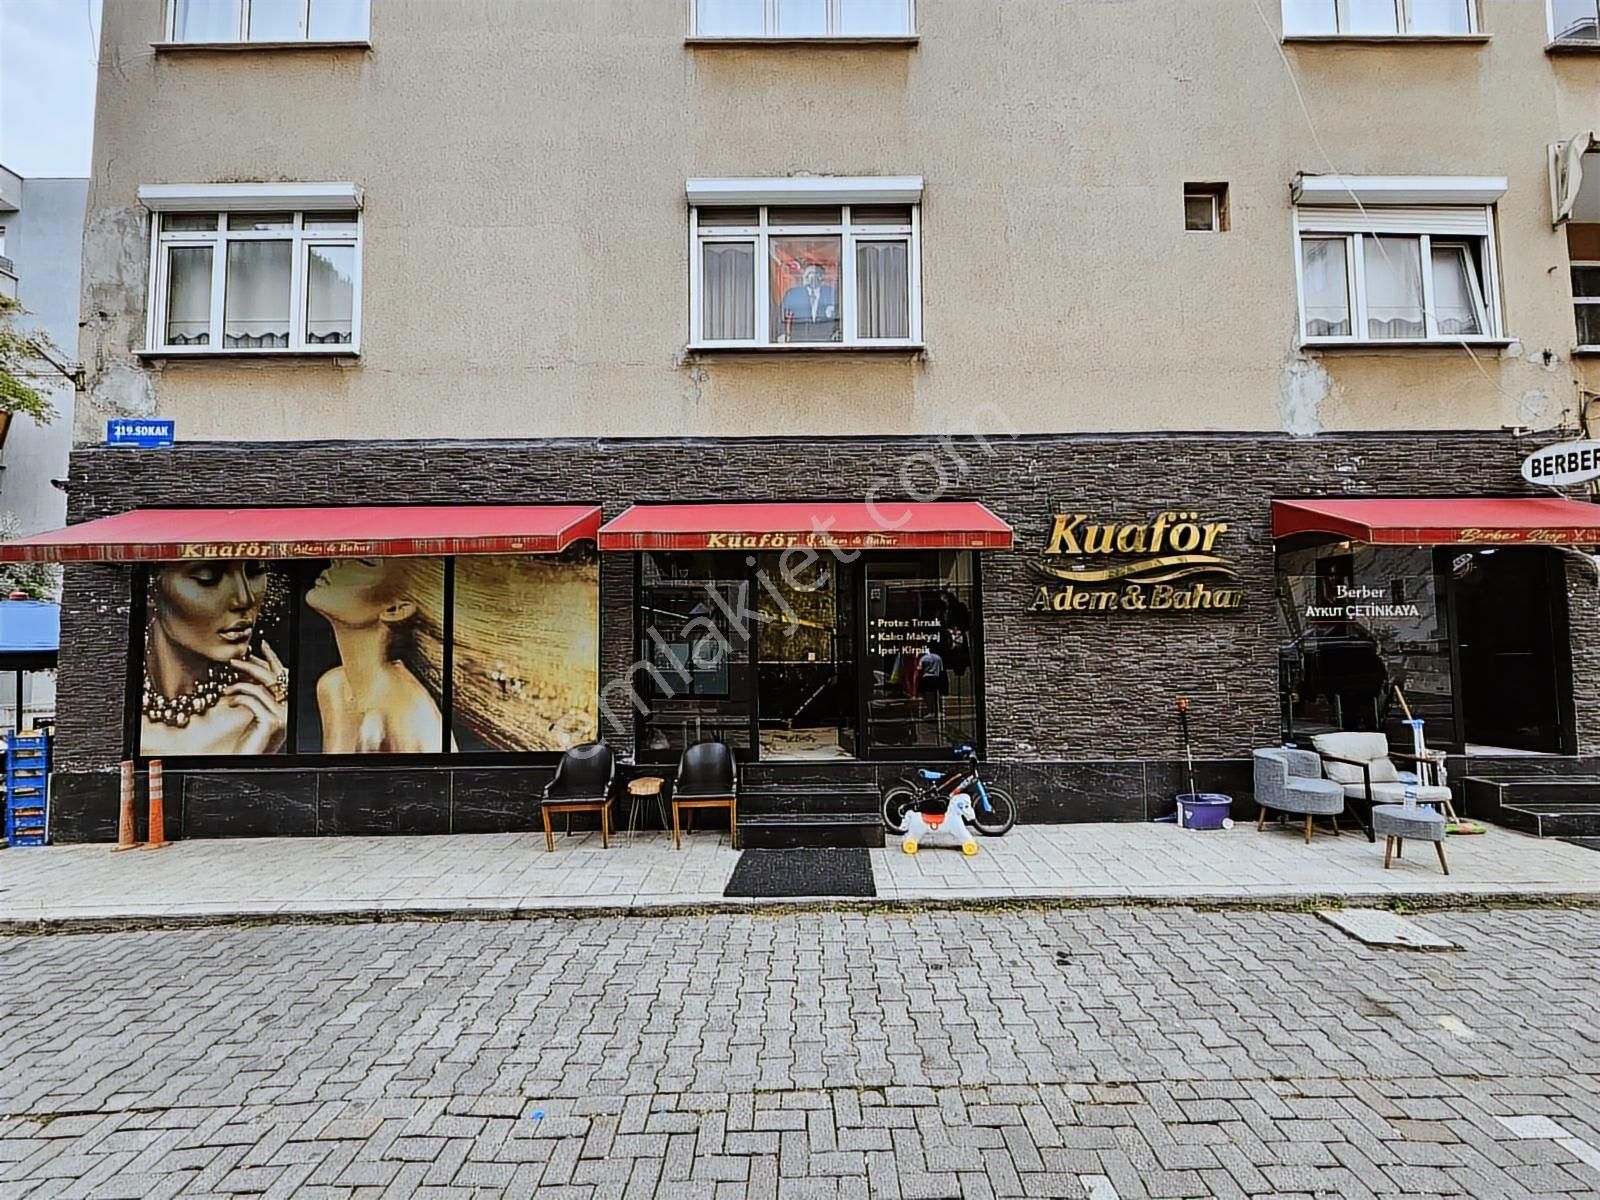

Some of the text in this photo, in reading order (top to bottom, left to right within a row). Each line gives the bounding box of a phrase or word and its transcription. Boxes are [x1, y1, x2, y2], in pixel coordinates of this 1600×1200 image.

[706, 533, 799, 548] Kuaför
[1045, 512, 1228, 554] Kuaför
[182, 543, 272, 557] Kuaför
[1336, 585, 1386, 599] Berber
[1305, 602, 1419, 619] AYKUT ÇETİNKAYA
